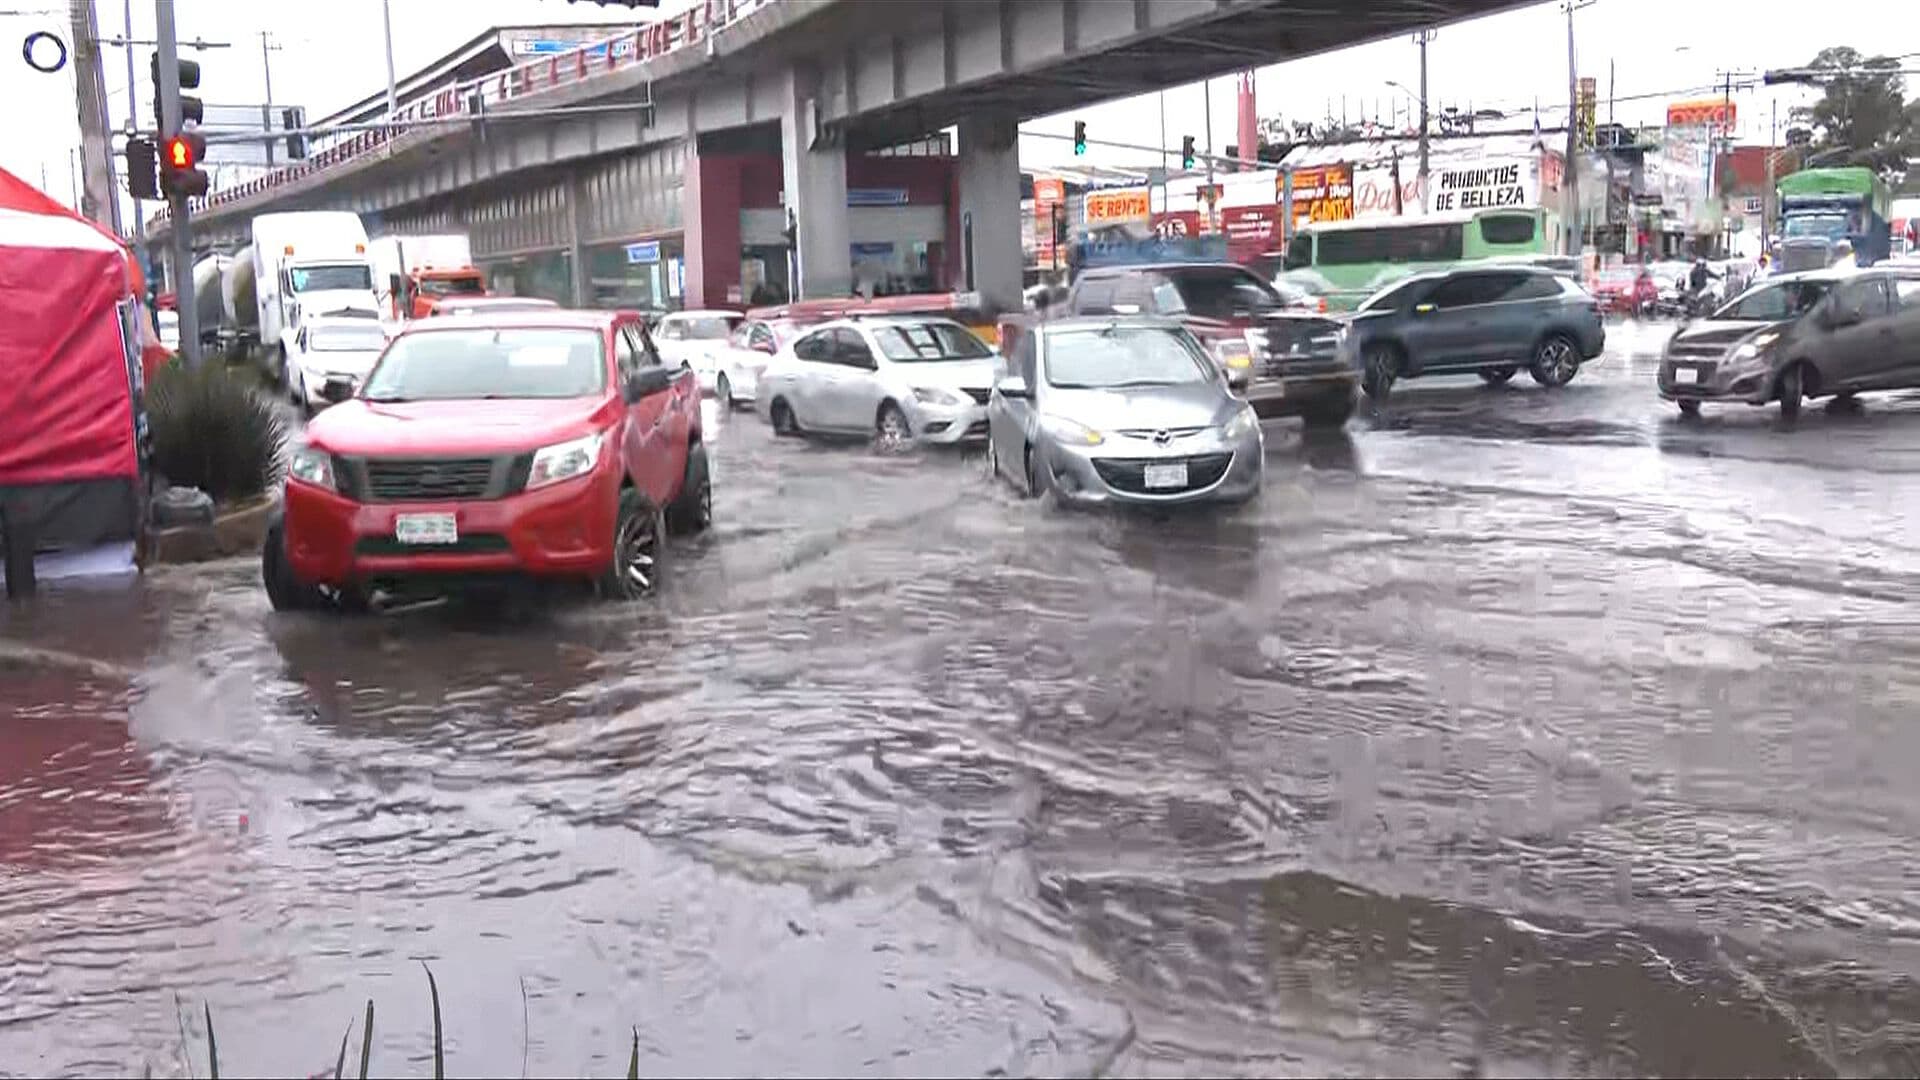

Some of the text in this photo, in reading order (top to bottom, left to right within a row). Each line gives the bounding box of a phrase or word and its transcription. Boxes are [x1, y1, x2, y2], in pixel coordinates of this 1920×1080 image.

[1441, 164, 1518, 189] PRODUCTOS
[1106, 197, 1146, 216] RENTA
[1436, 192, 1454, 212] DE
[1460, 185, 1524, 209] BELLEZA
